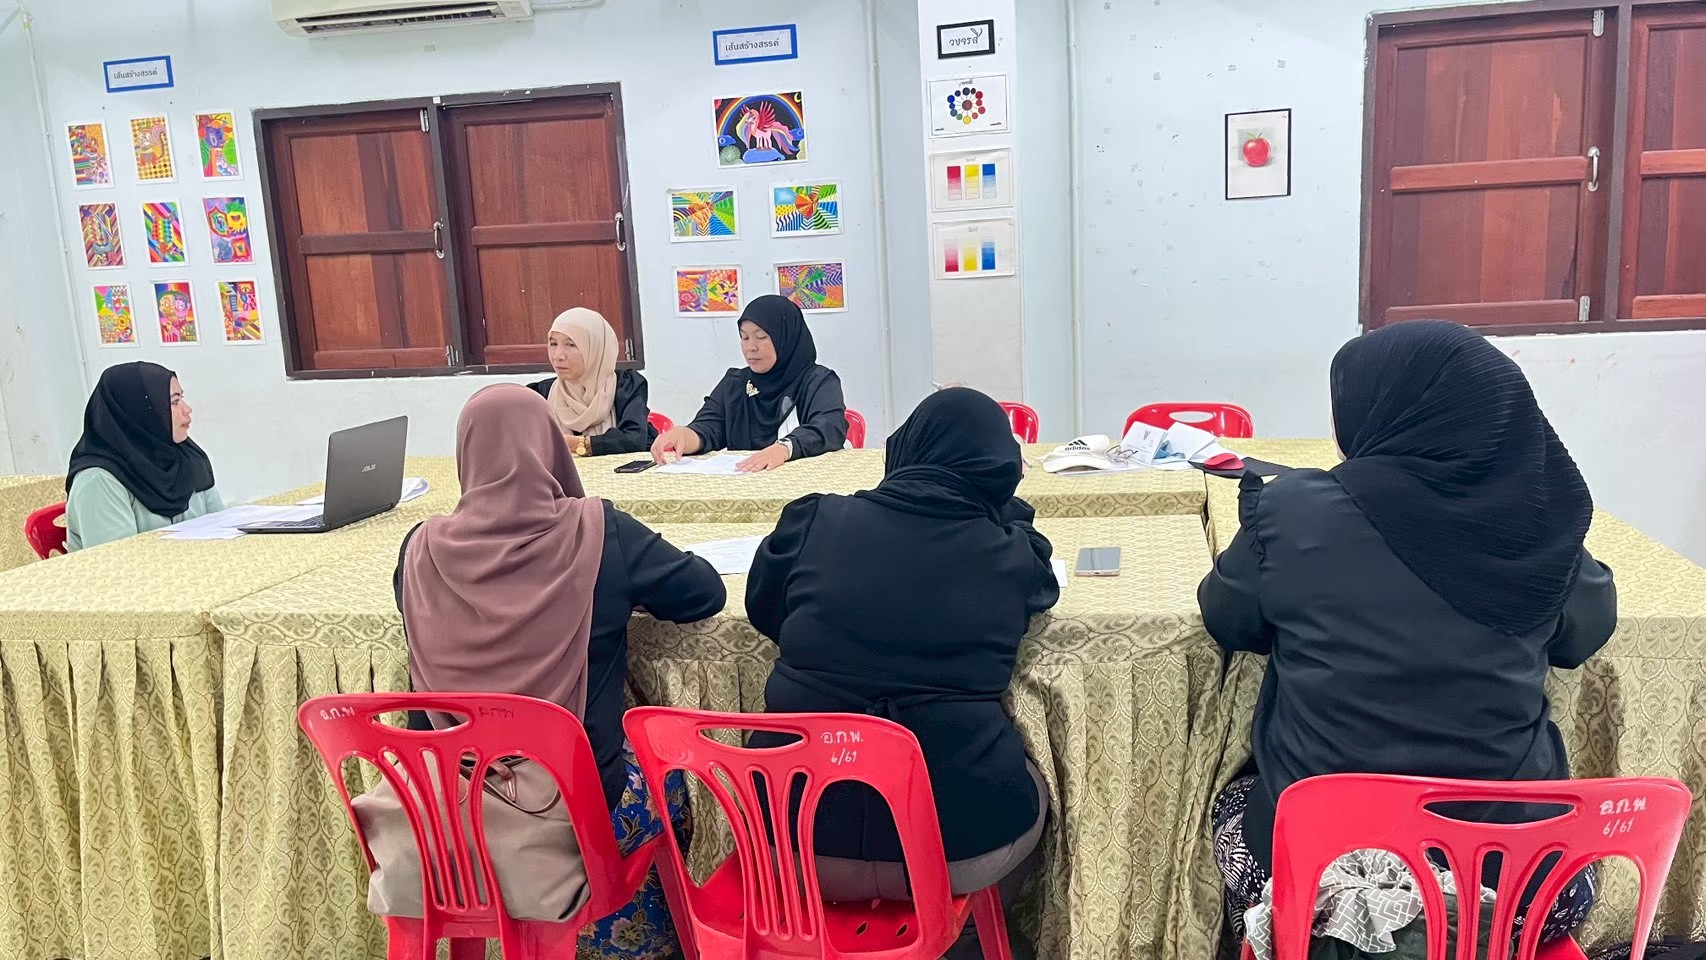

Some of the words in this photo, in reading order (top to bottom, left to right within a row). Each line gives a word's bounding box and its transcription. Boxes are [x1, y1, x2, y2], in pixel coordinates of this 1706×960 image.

[725, 38, 779, 51] เส้นสร้างสรรค์
[831, 747, 857, 766] 6/61
